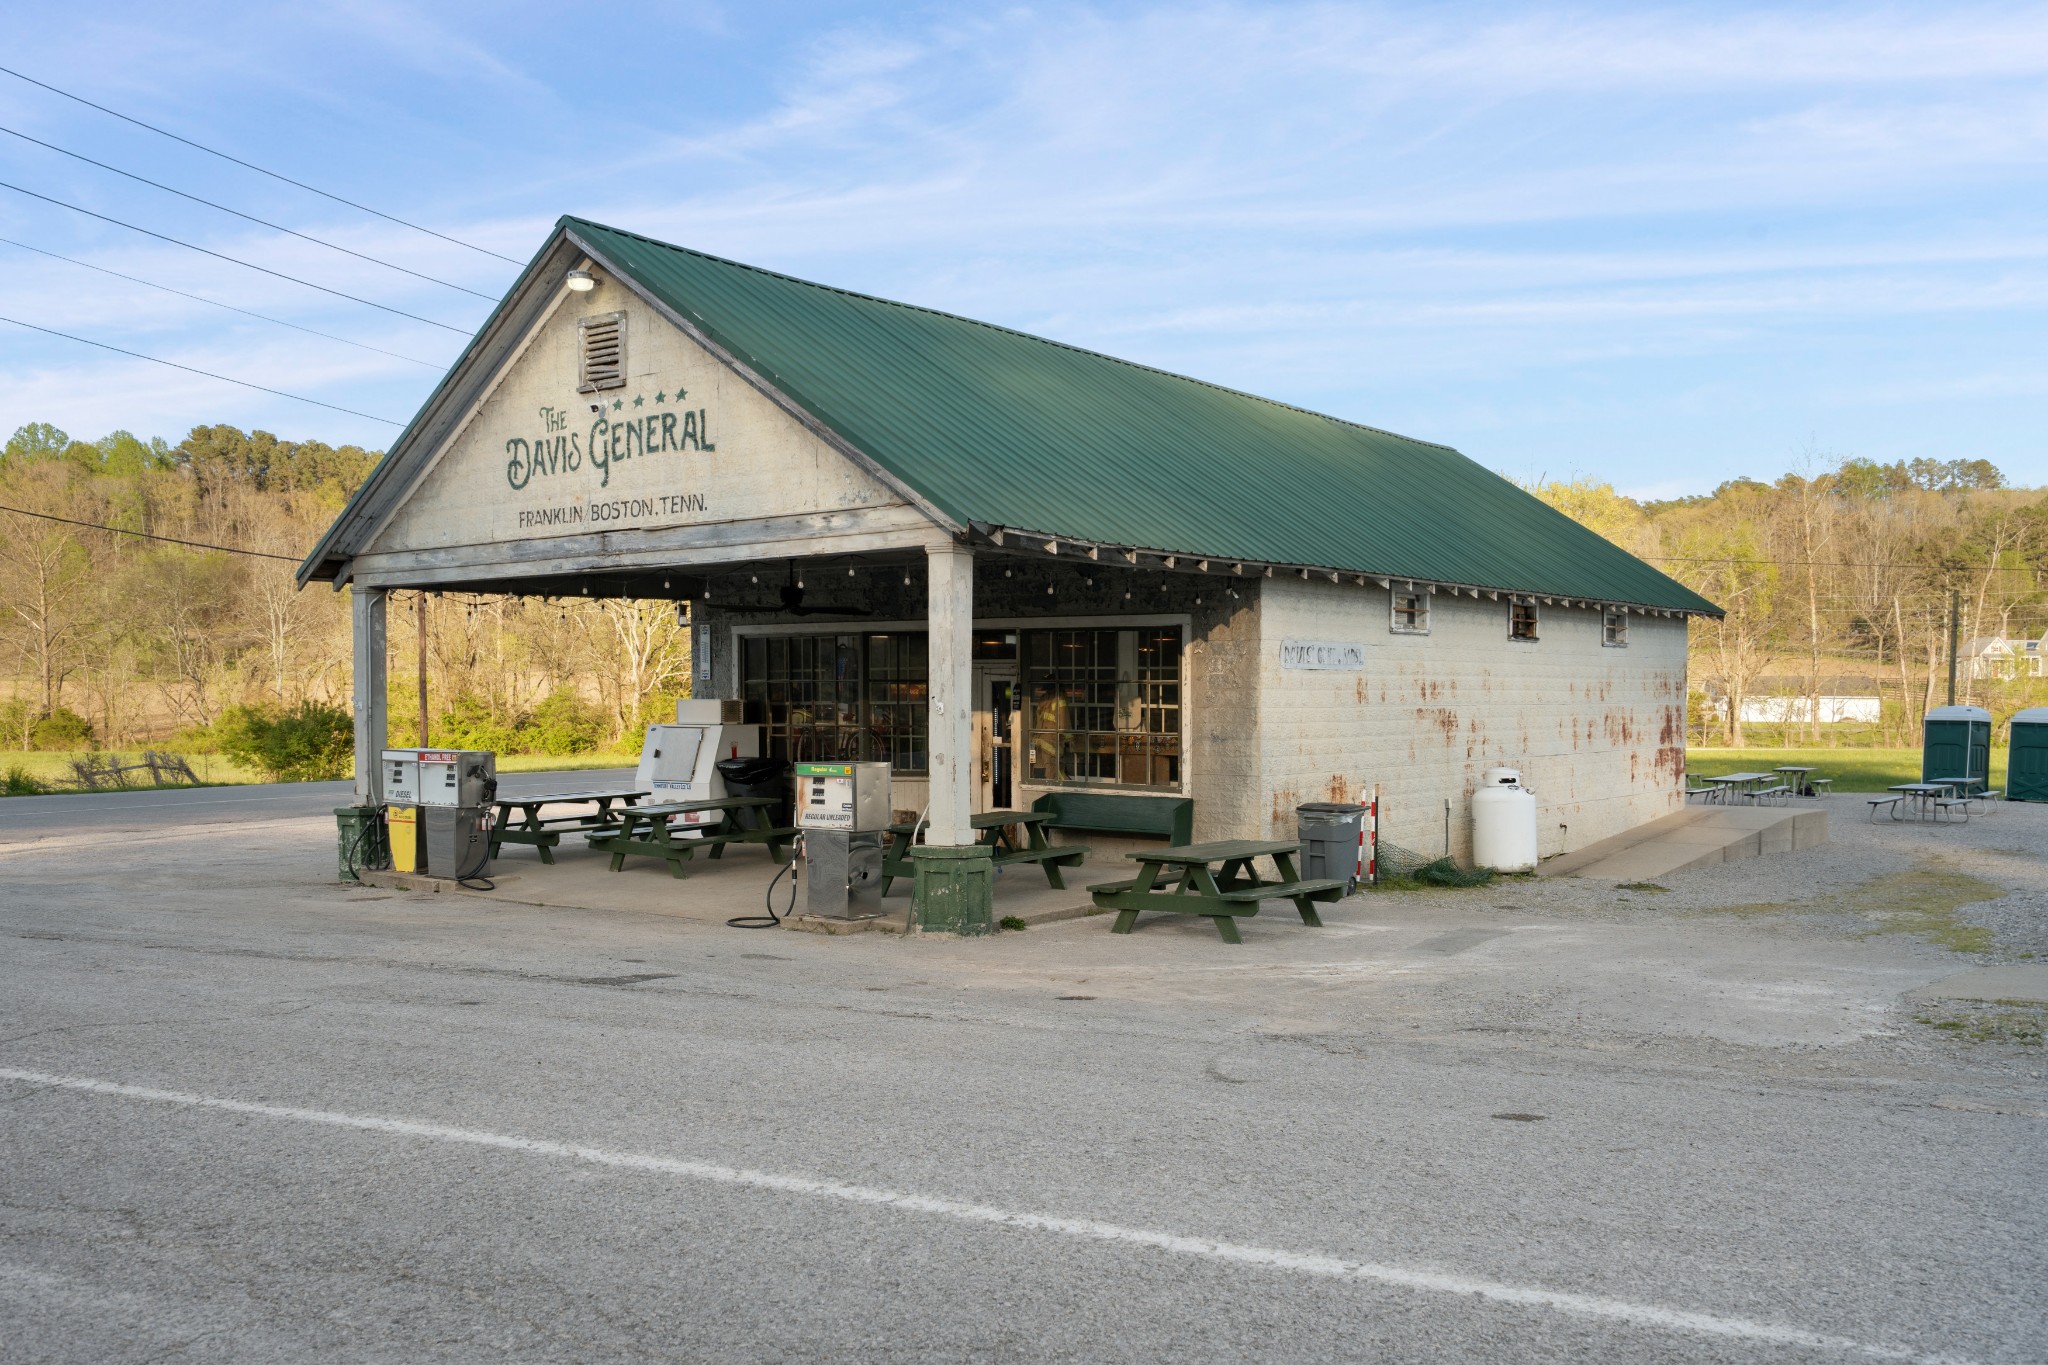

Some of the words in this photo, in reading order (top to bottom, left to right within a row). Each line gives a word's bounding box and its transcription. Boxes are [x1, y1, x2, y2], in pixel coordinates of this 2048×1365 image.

[539, 406, 568, 433] THE
[506, 432, 582, 490] DAVIS
[589, 408, 715, 488] GENERAL
[659, 493, 708, 515] TENN.
[442, 753, 452, 761] FREE
[395, 790, 412, 799] DIESEL
[805, 813, 826, 821] REGULAR
[826, 814, 852, 822] UNLEADED
